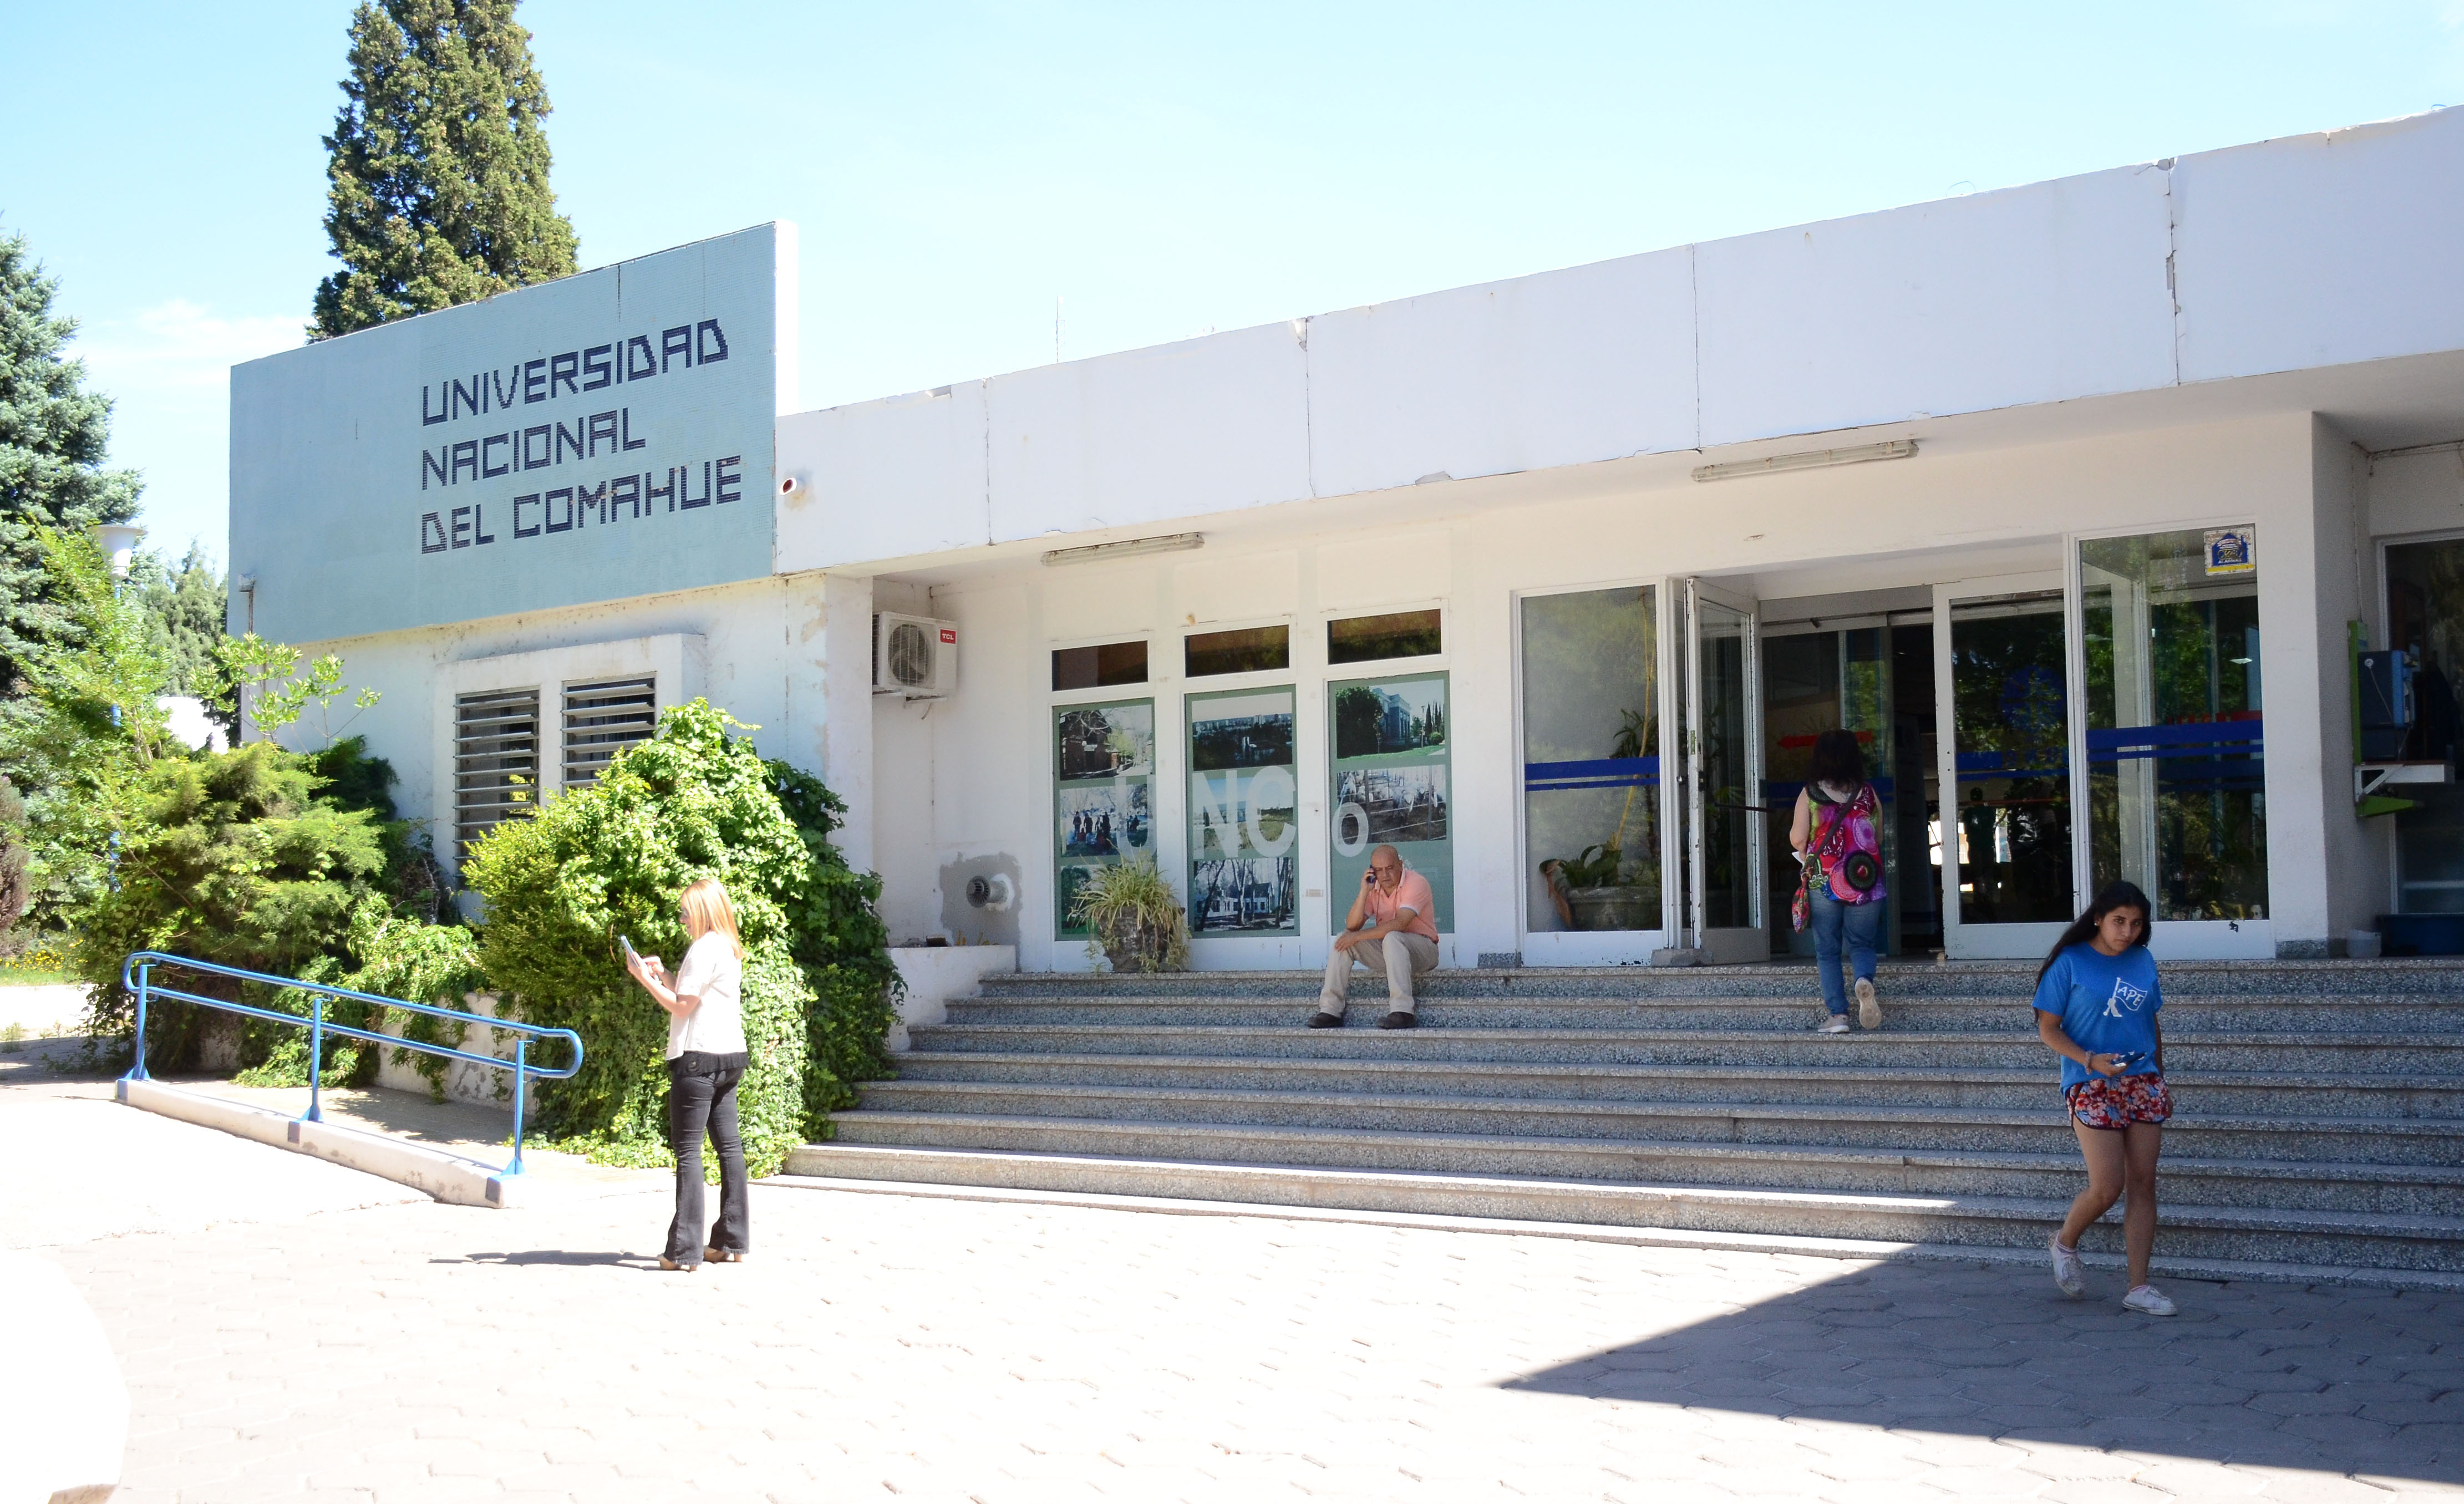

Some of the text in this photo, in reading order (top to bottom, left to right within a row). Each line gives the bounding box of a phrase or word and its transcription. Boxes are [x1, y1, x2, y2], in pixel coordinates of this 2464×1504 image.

[423, 319, 728, 426] UNIVERSIDAD
[422, 408, 646, 490] NACIONAL
[421, 455, 741, 555] DEL COMAHUE
[2117, 986, 2145, 1006] APE
